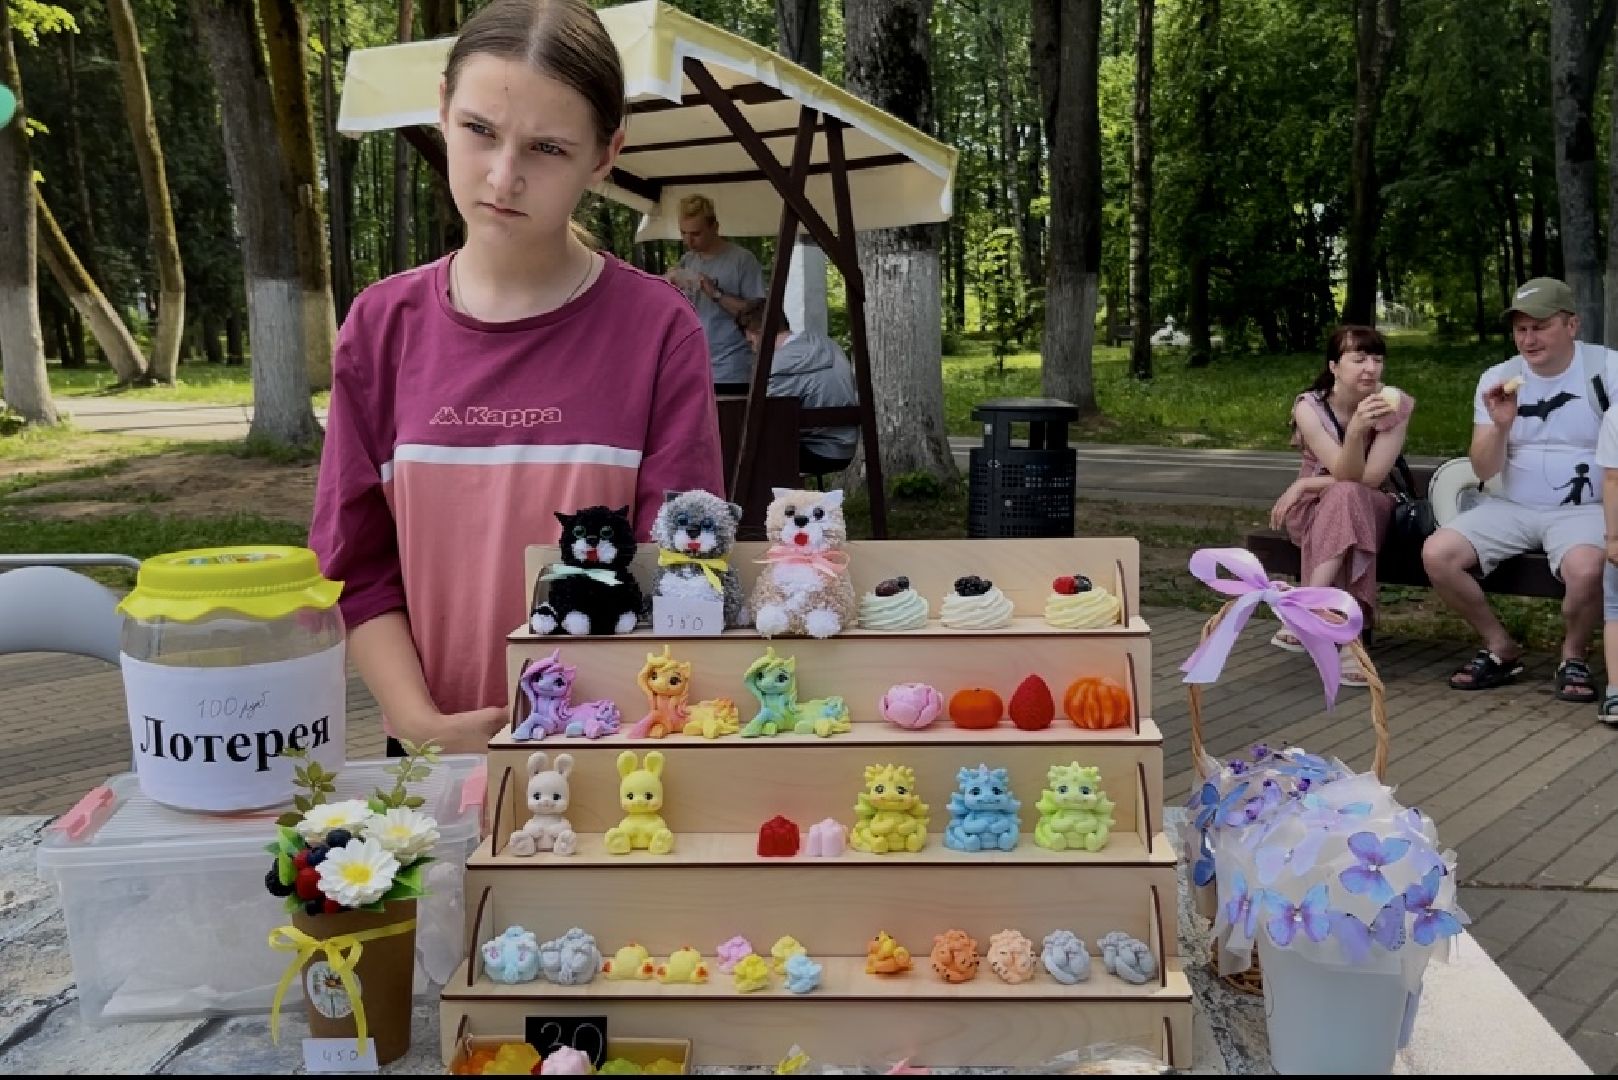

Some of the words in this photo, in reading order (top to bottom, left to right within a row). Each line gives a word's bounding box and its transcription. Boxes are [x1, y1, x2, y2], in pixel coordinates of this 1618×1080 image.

[466, 406, 562, 427] Kappa
[198, 698, 238, 718] 100
[140, 715, 330, 772] Лотерея
